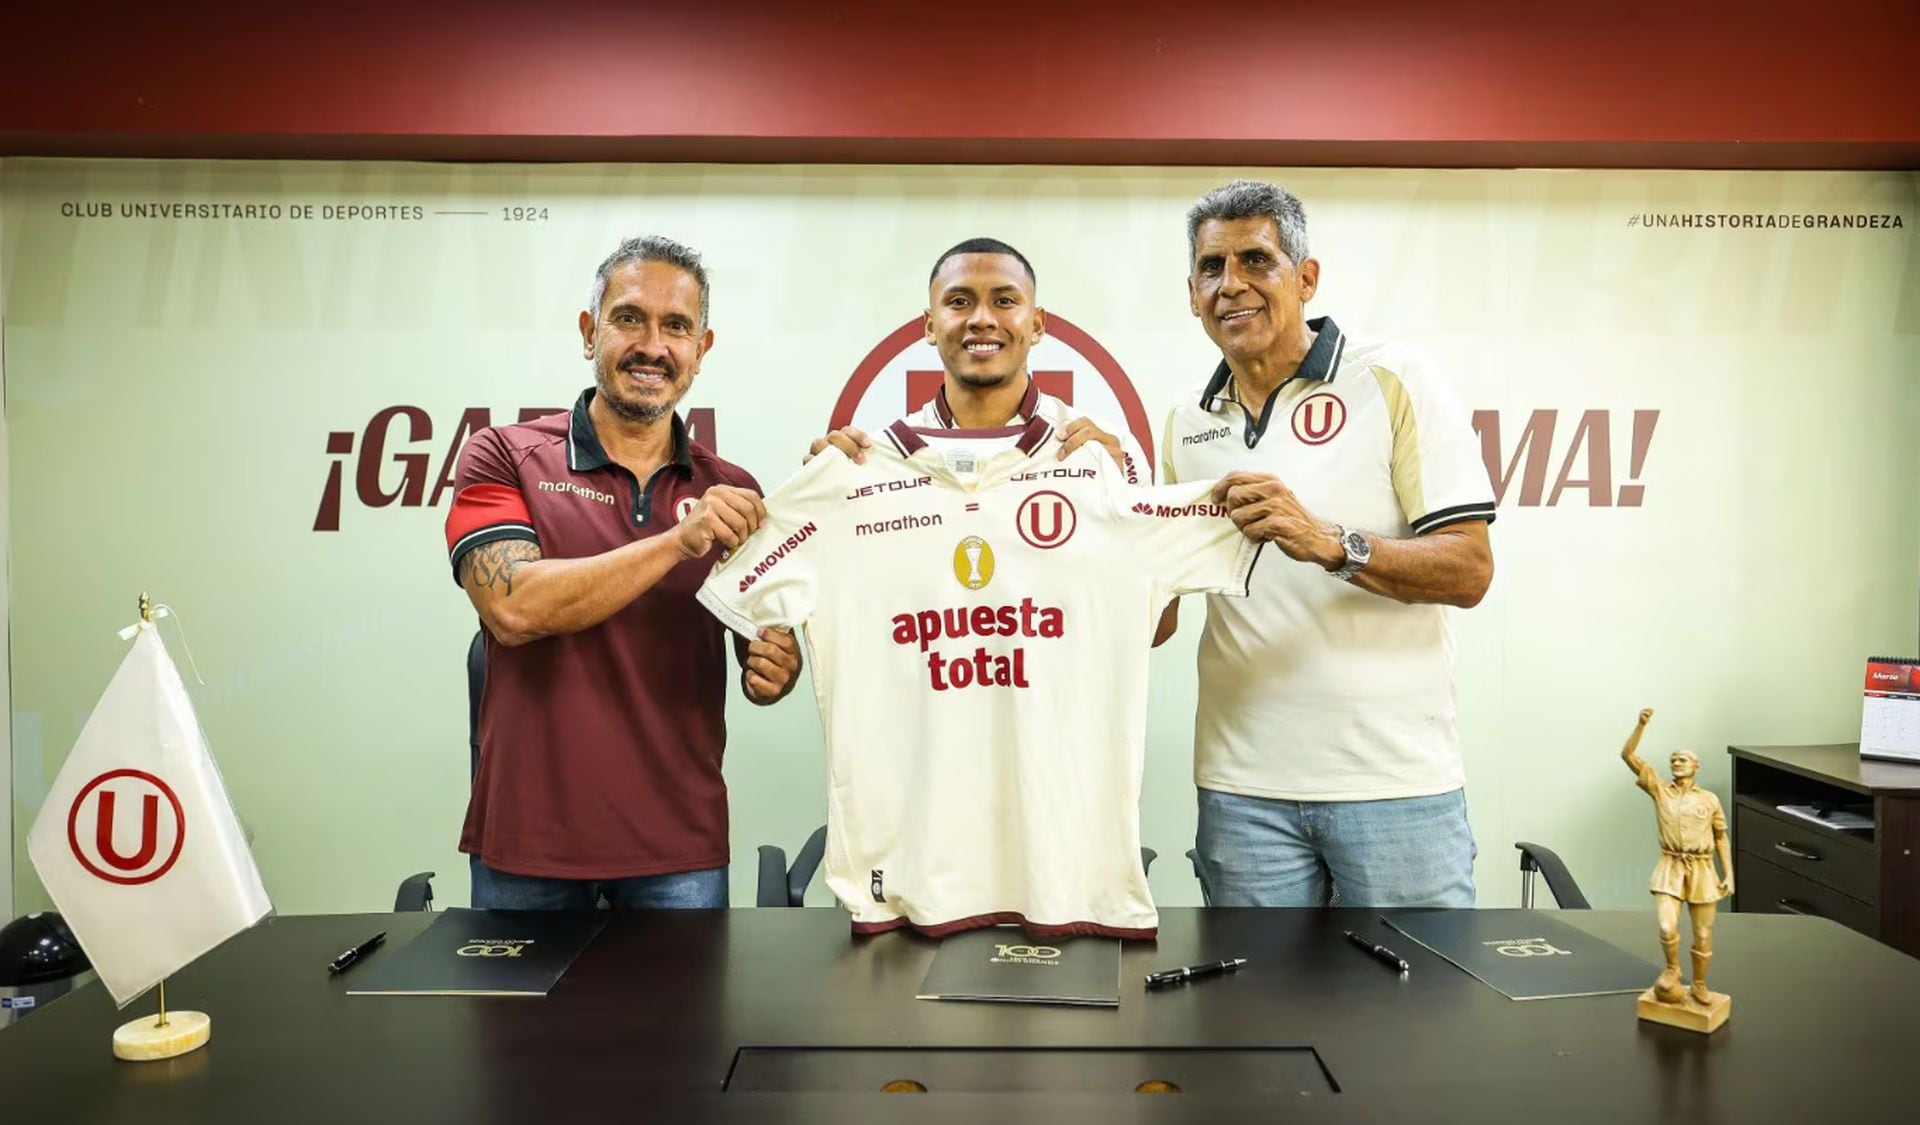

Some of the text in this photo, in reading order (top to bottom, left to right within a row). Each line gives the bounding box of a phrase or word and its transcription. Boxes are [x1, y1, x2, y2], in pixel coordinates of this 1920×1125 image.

[61, 202, 549, 222] CLUB UNIVERSITARIO DE DEPORTES 1924
[1627, 213, 1904, 229] #UNAHISTORIADEGRANDEZA
[1303, 400, 1333, 439] U
[1182, 426, 1232, 447] marathon
[1010, 468, 1097, 482] JETOUR
[539, 479, 615, 506] marathon
[845, 476, 932, 500] JETOUR
[856, 513, 943, 537] marathon
[1030, 501, 1063, 542] U
[753, 521, 818, 577] MOVISUN
[891, 597, 1065, 653] apuesta
[927, 647, 1030, 692] total
[96, 790, 159, 871] U
[994, 944, 1061, 959] 100
